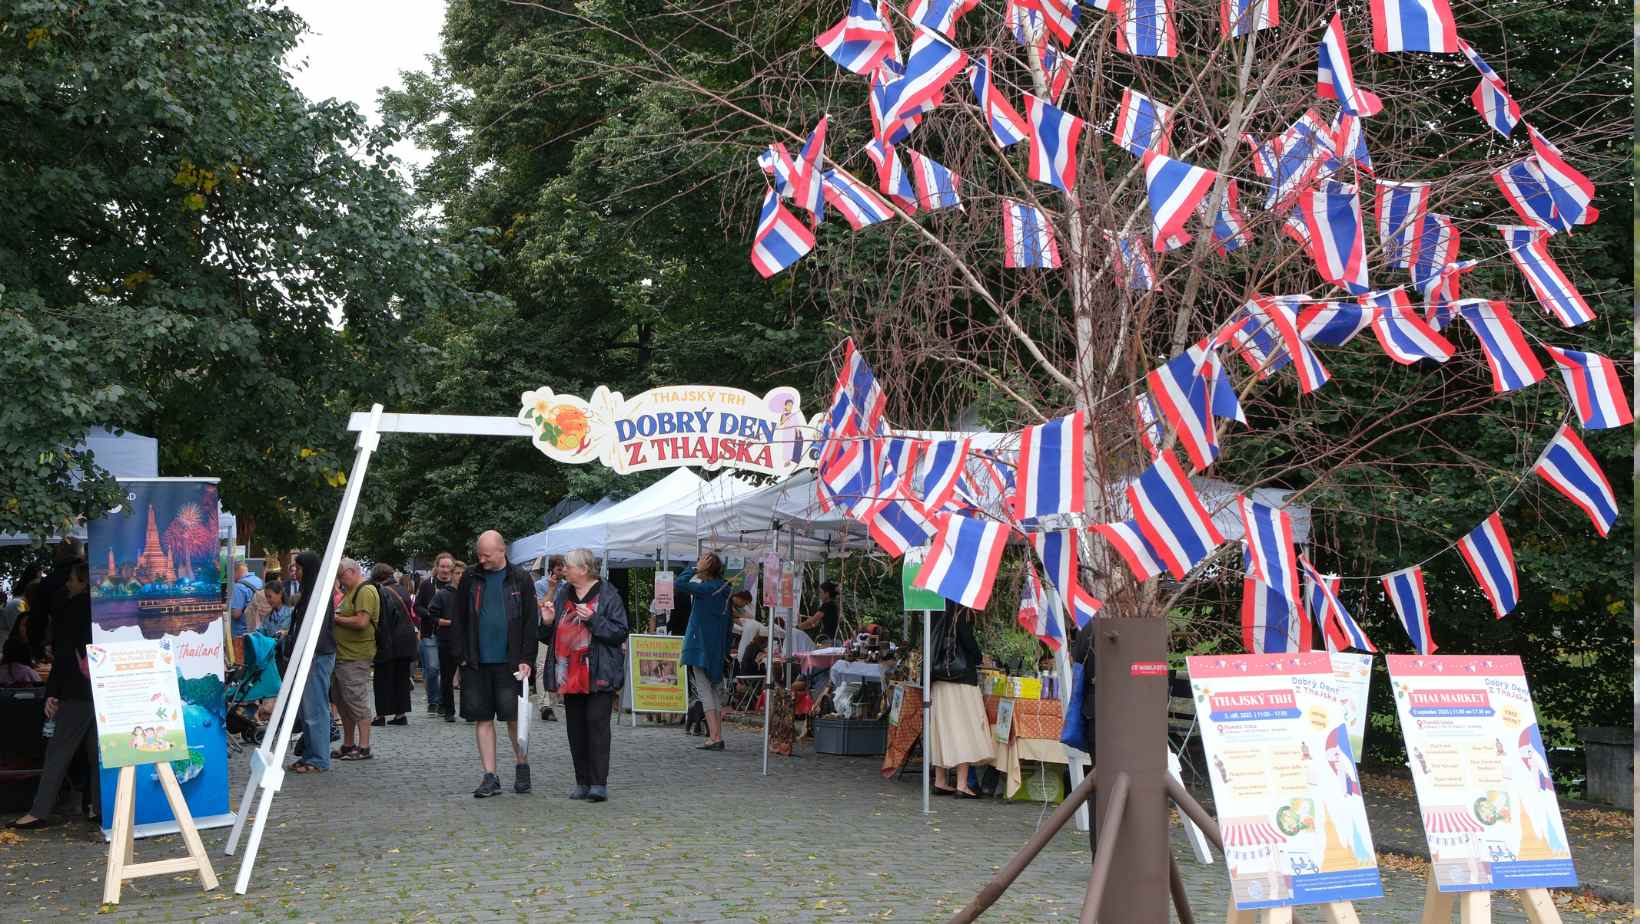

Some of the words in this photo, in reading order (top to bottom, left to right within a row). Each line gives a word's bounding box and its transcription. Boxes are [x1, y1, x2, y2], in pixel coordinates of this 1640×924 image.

[652, 388, 714, 402] THAJSKÝ
[719, 392, 746, 406] TRH
[615, 407, 714, 442] DOBRÝ
[719, 411, 777, 444] DEN
[623, 440, 647, 466] Z
[651, 436, 774, 469] THAJSKA
[1214, 693, 1265, 707] THAJSKÝ
[1269, 693, 1294, 705] TRH
[1439, 693, 1485, 704] MARKET
